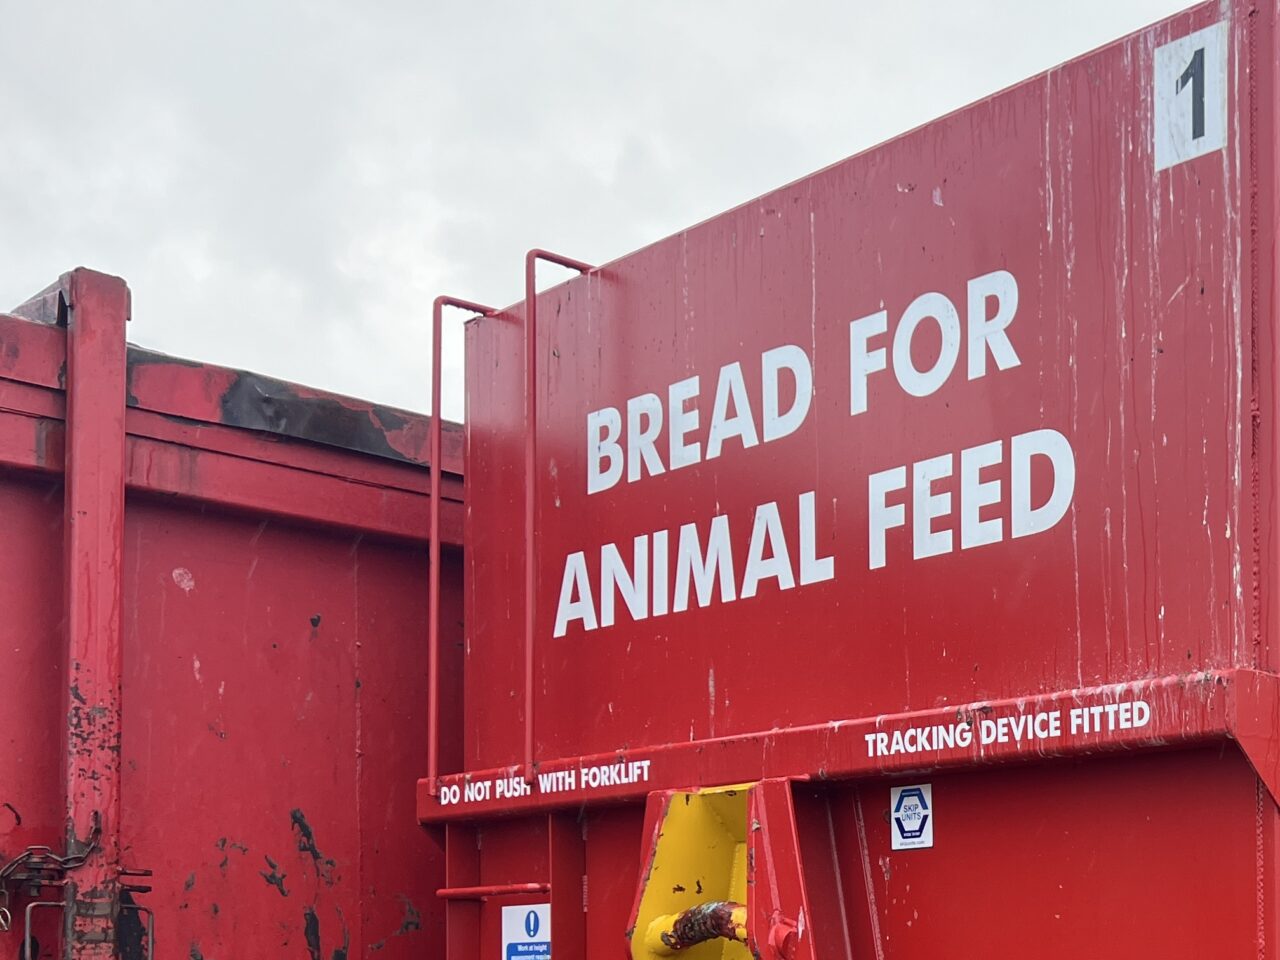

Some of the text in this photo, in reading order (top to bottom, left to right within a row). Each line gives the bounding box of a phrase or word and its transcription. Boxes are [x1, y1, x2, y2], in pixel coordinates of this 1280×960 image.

[1175, 46, 1206, 141] 1
[586, 269, 1022, 496] BREAD FOR
[552, 427, 1077, 639] ANIMAL FEED
[864, 700, 1152, 758] TRACKING DEVICE FITTED
[440, 759, 652, 806] DO NOT PUSH WITH FORKLIFT
[903, 803, 920, 814] SKIP
[901, 811, 922, 822] UNITS
